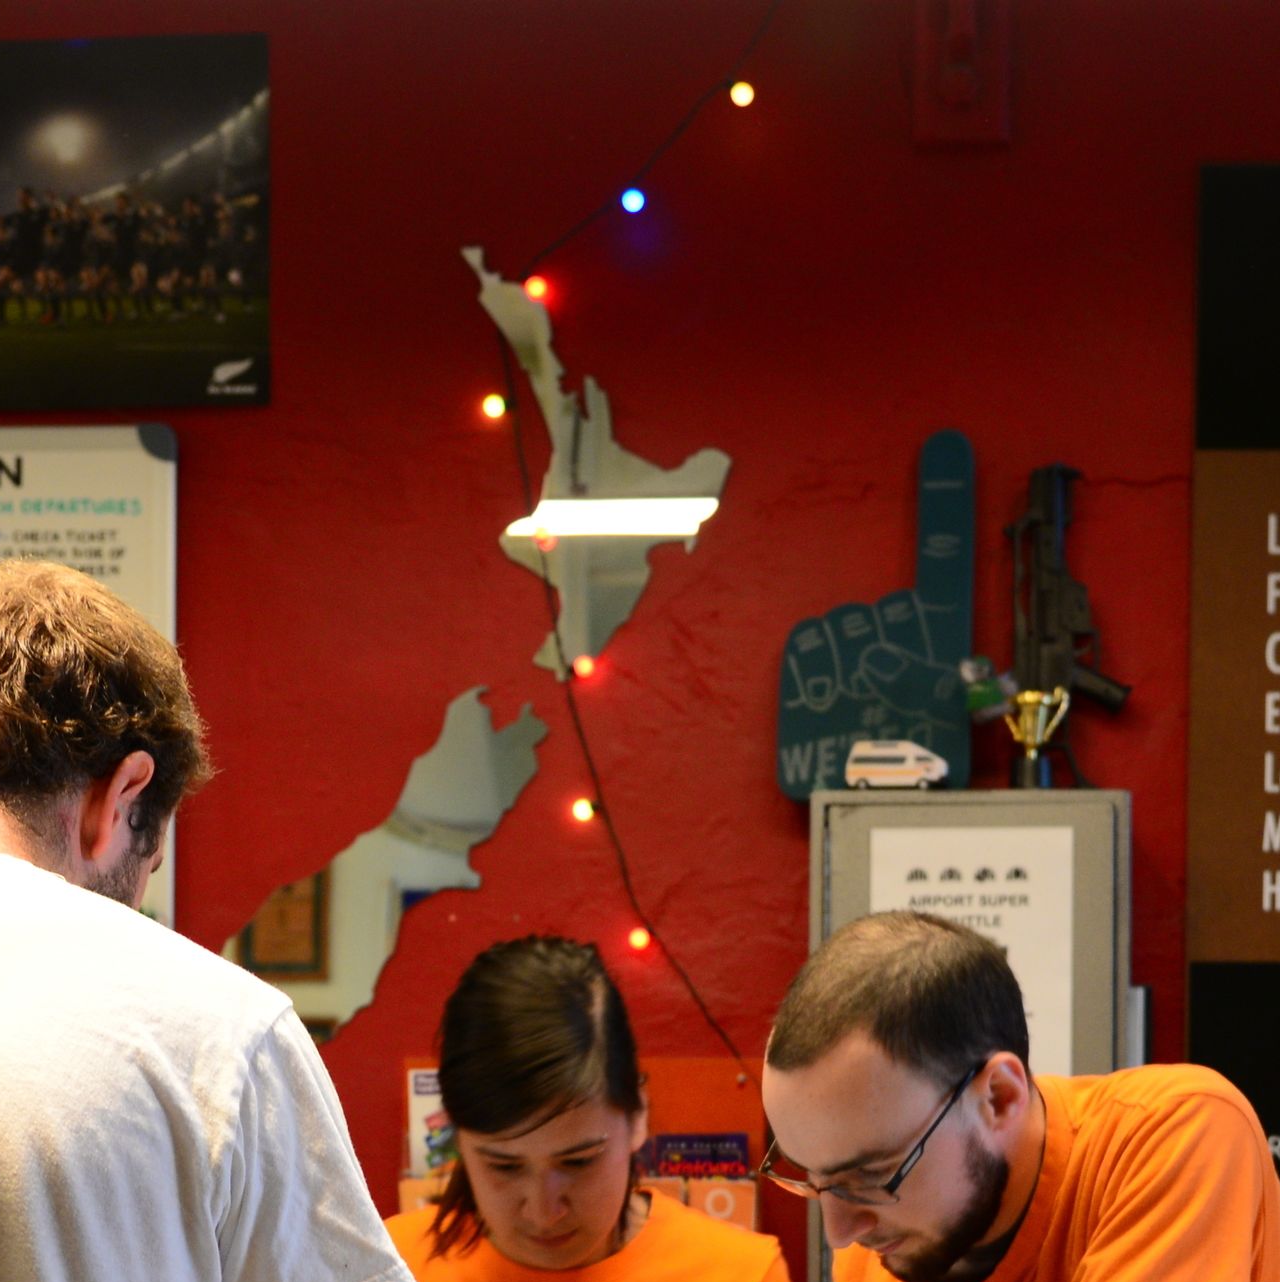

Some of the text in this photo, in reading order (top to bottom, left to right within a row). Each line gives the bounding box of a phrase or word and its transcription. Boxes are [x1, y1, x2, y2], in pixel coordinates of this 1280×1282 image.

[22, 497, 142, 516] DEPARTURES
[909, 894, 1029, 908] AIRPORT SUPER
